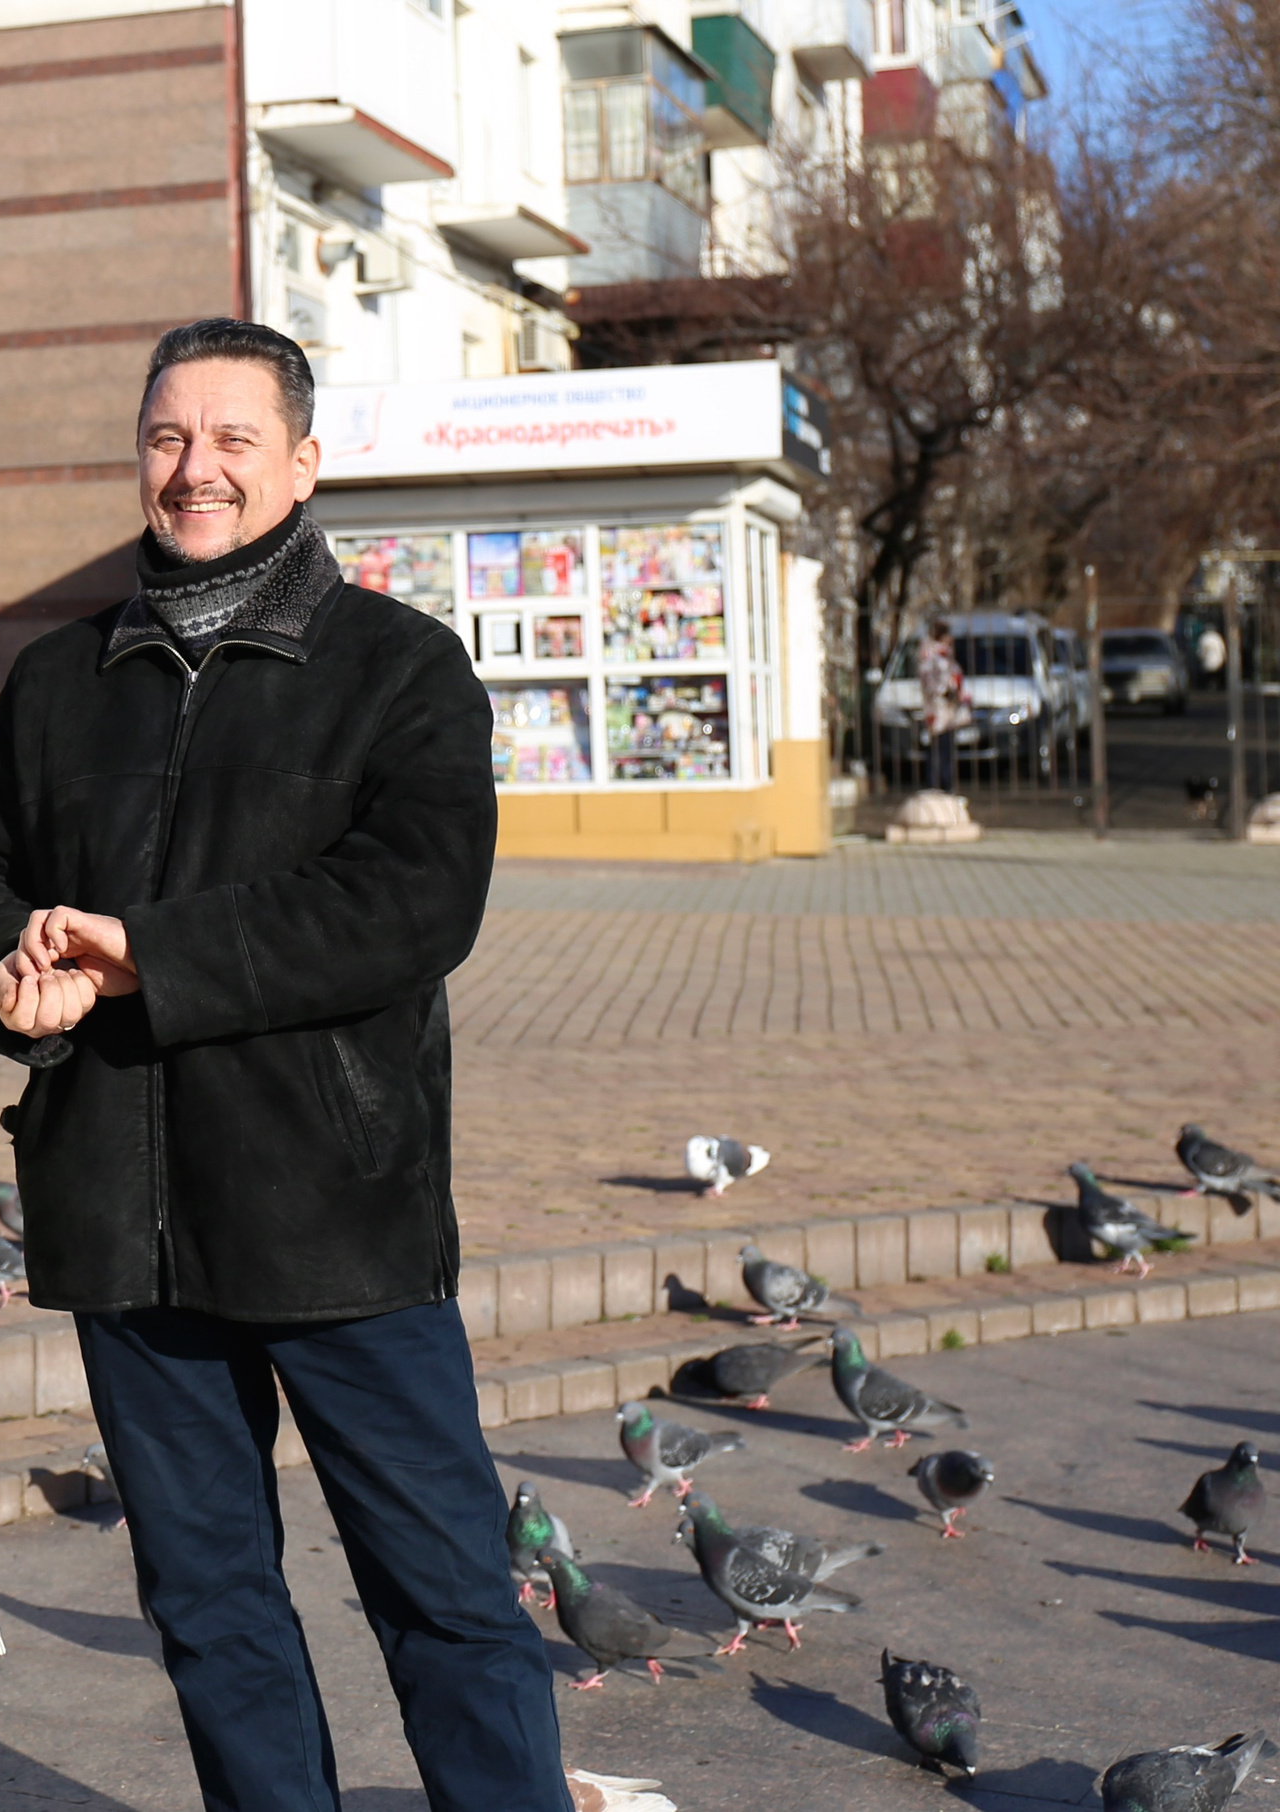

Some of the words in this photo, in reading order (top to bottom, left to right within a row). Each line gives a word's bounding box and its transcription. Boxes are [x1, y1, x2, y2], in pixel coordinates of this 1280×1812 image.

[452, 389, 559, 411] АКЦИОНЕРНОЕ
[564, 386, 645, 407] ОБЩЕСТВО
[423, 417, 676, 450] «Краснодарпечать»
